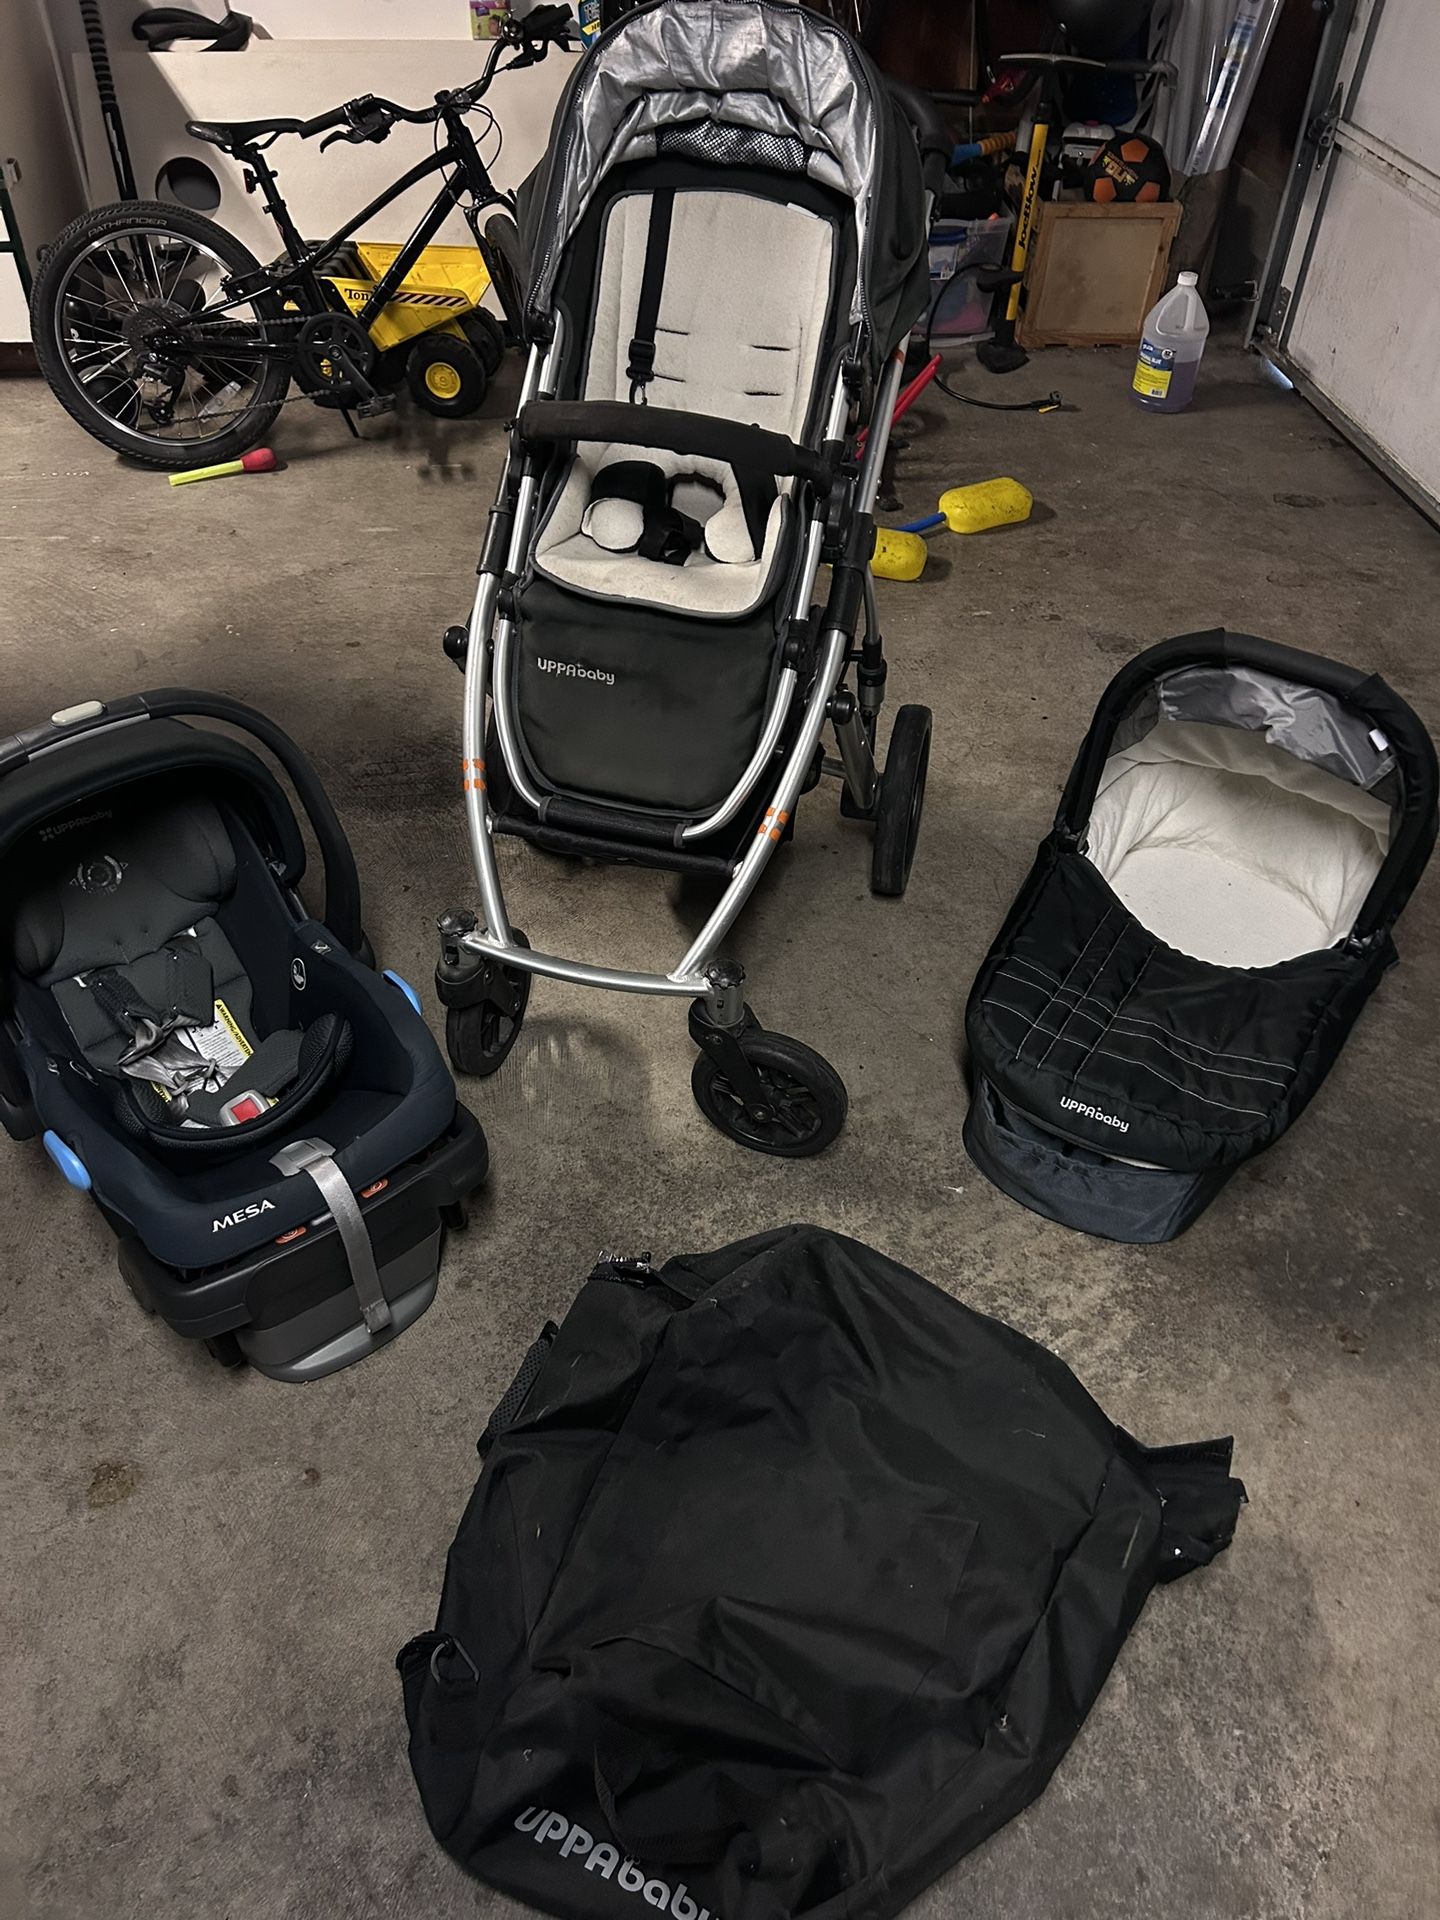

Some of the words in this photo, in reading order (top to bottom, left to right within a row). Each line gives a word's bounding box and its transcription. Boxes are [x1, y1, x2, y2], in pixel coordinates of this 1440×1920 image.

[88, 217, 168, 238] PATHFINDER
[344, 287, 373, 301] Ton
[537, 657, 615, 685] UPPAbaby
[1060, 1096, 1130, 1133] UPPAbaby
[212, 1199, 276, 1233] MESA
